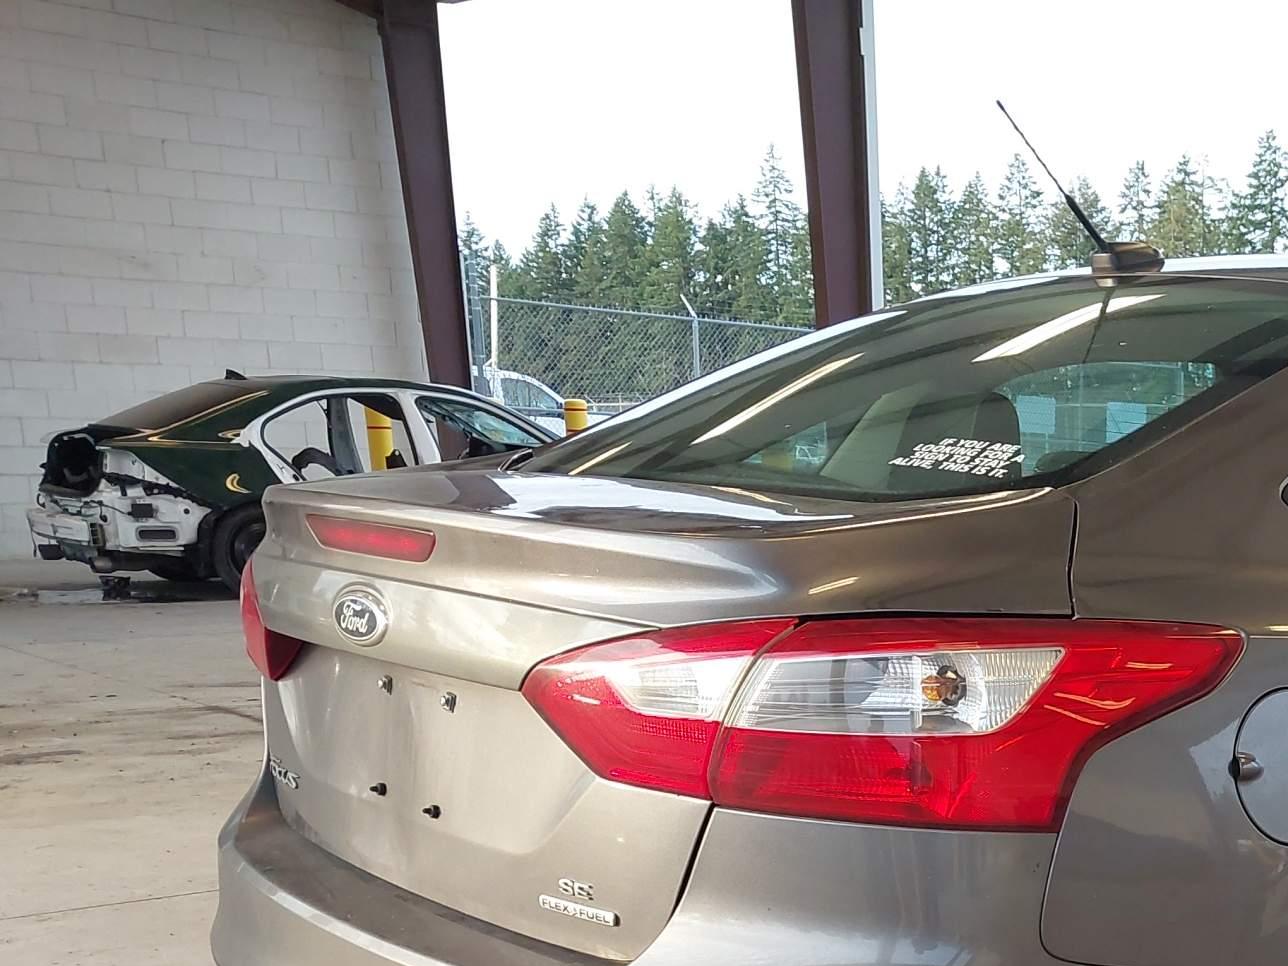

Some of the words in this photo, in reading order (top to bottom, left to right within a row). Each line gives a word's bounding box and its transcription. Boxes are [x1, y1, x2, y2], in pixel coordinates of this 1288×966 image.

[913, 443, 980, 456] LOOKING
[980, 450, 1012, 461] FOR
[1010, 454, 1025, 462] A
[957, 439, 989, 449] YOU
[987, 443, 1021, 452] ARE
[888, 457, 935, 469] ALIVE,
[938, 461, 974, 472] THIS
[971, 466, 991, 475] IS
[988, 469, 1008, 478] IT.
[910, 451, 949, 461] SIGN
[950, 455, 971, 463] TO
[970, 457, 1011, 468] STAY
[341, 601, 370, 633] Ford
[559, 878, 594, 900] SE
[542, 898, 571, 914] FLEX
[579, 908, 611, 924] FUEL
